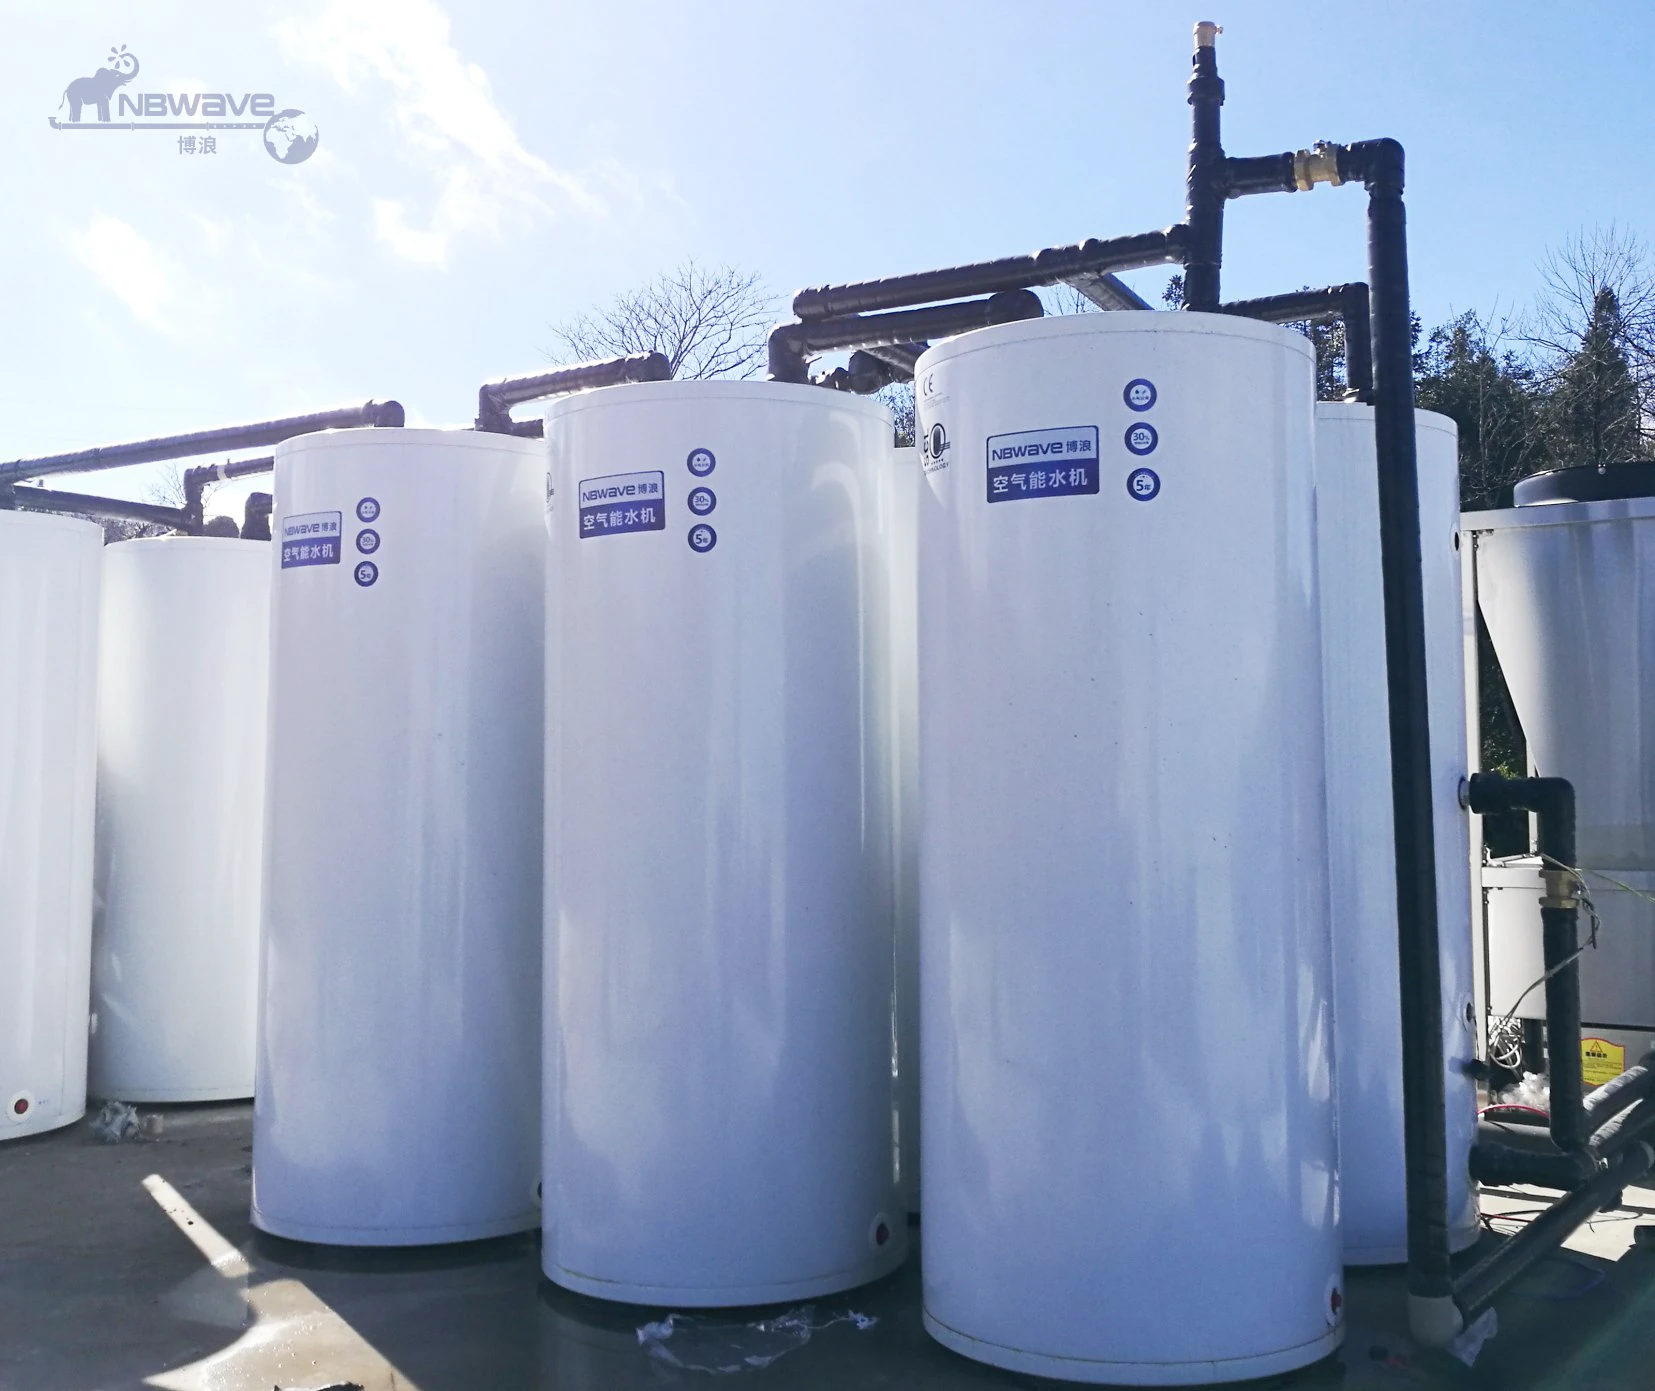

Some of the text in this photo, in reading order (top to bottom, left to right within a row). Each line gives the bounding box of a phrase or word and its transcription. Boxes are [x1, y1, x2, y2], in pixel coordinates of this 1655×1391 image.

[1066, 439, 1092, 453] 博浪
[637, 483, 658, 495] 博浪
[993, 468, 1088, 493] 空气能水机
[583, 507, 656, 530] 空气能水机
[283, 543, 333, 563] 空气能水机
